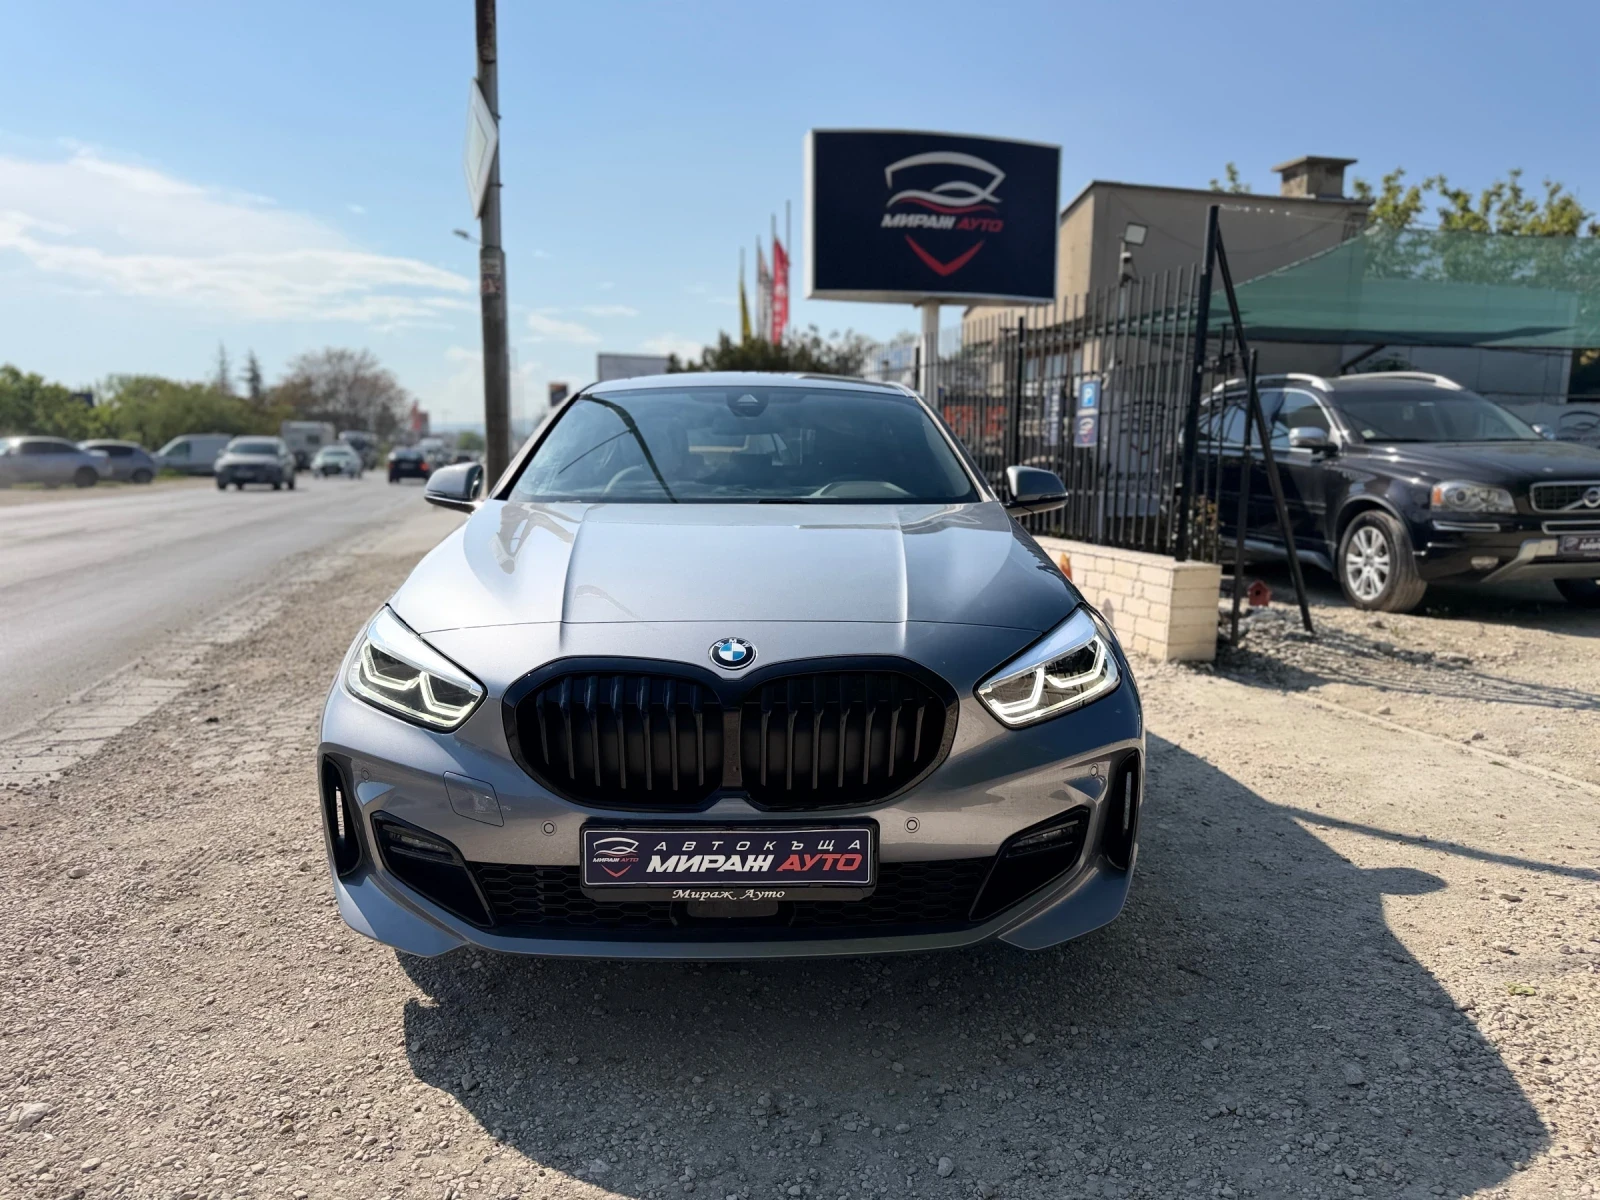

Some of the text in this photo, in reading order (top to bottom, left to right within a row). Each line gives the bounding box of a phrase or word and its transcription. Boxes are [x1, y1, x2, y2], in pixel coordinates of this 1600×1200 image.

[880, 213, 1003, 232] МИРАЖ АУТО
[653, 839, 861, 851] АВТОКЪЩА
[646, 854, 863, 873] МИРАЖ АУТО
[672, 888, 785, 901] Мираж Ауто
